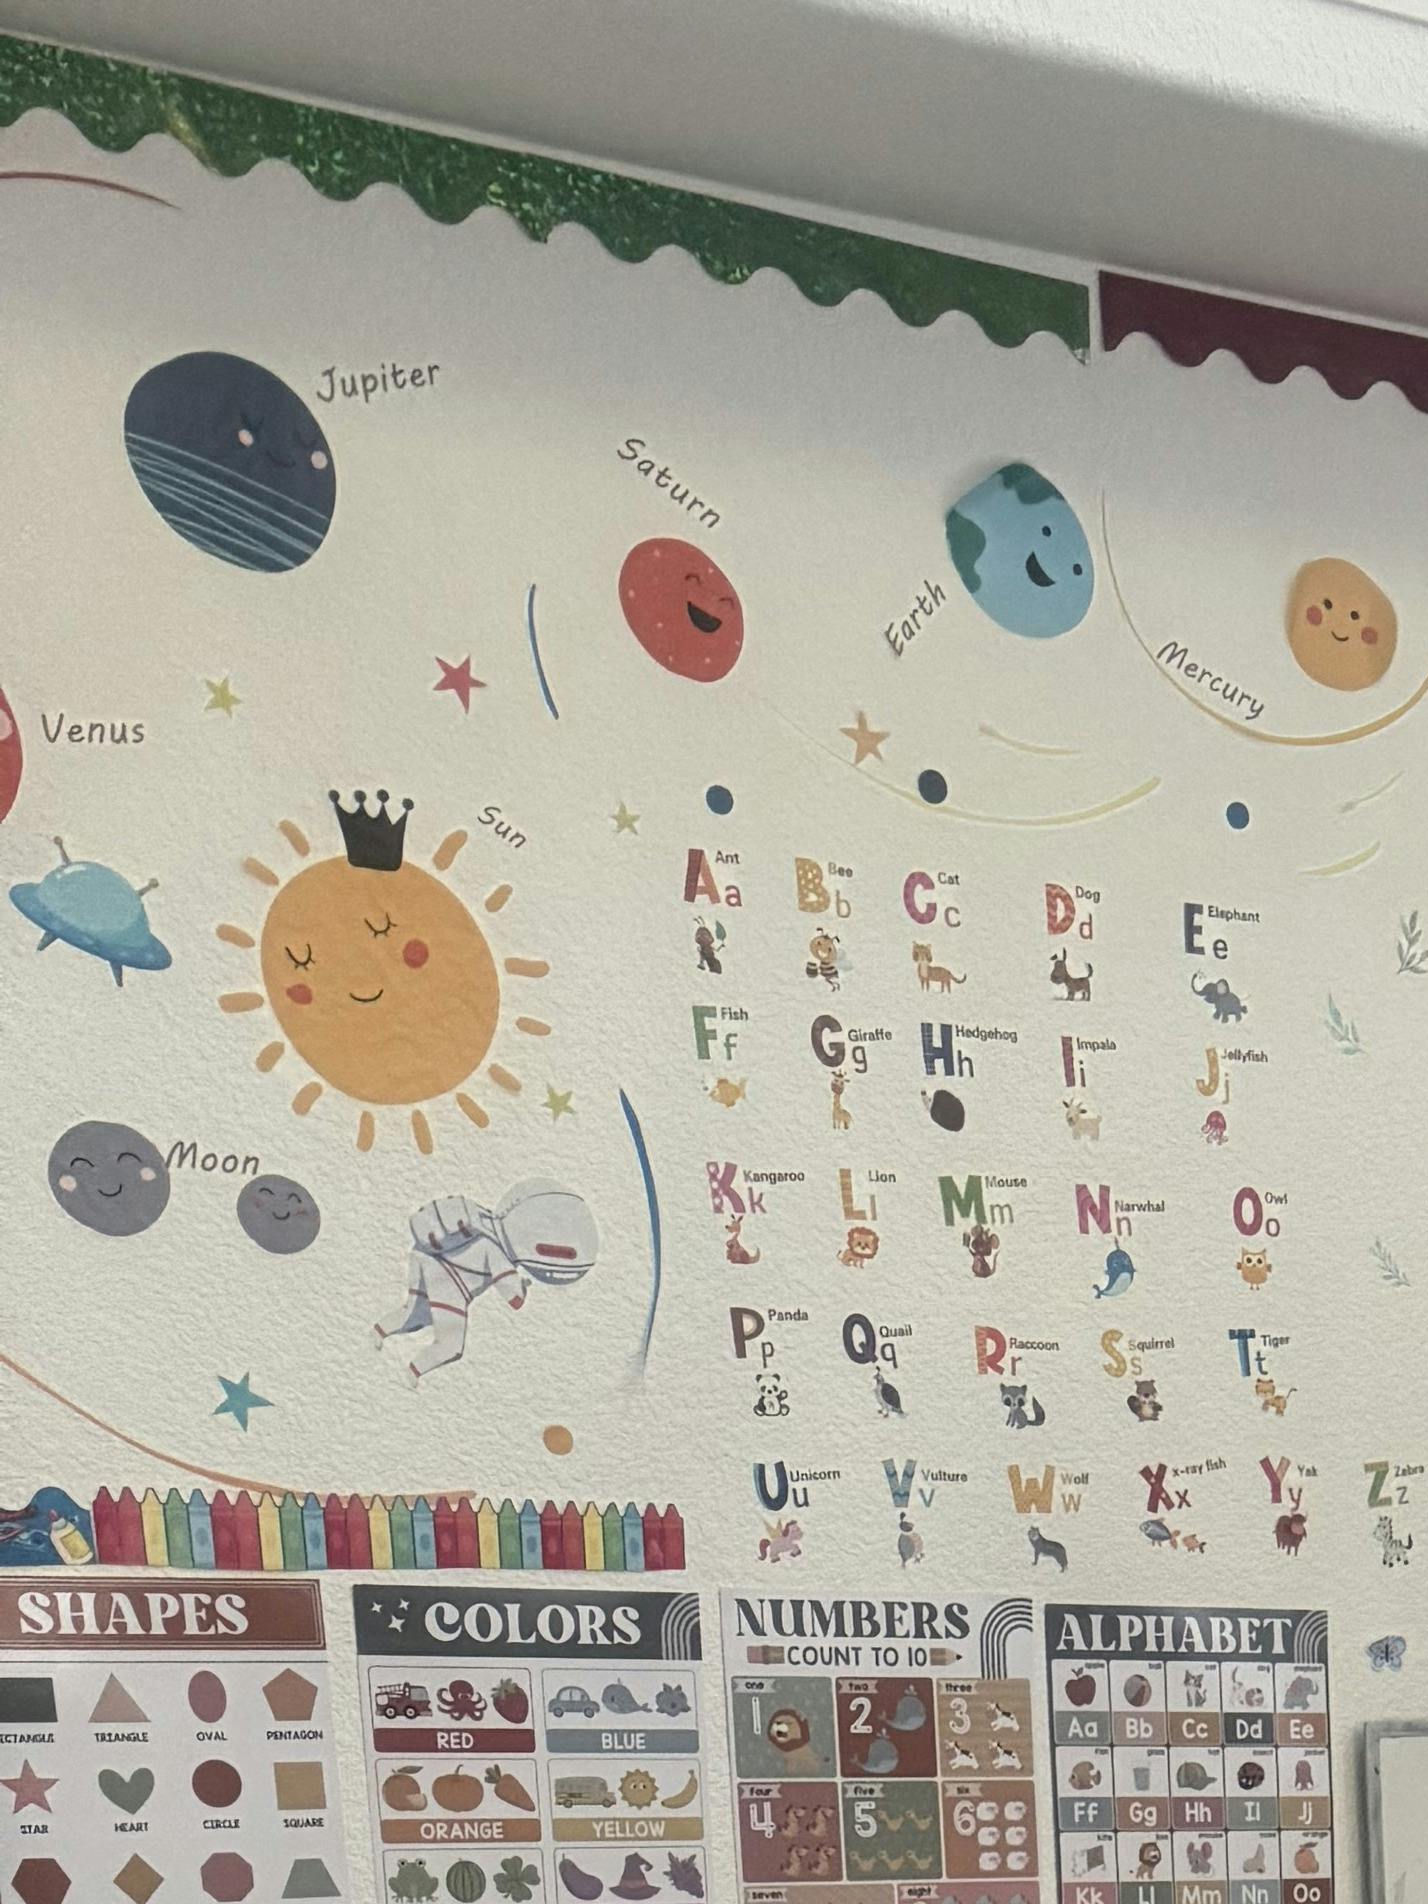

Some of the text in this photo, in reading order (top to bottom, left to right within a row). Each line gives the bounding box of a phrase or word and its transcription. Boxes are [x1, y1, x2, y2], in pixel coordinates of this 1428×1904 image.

[316, 359, 441, 405] Jupiter
[617, 436, 722, 530] Saturn
[886, 580, 947, 658] Earth
[1158, 640, 1266, 720] Mercury
[41, 712, 146, 745] Venus
[478, 803, 528, 850] Sun
[715, 850, 740, 865] Ant
[938, 872, 961, 886] Cat
[1075, 886, 1101, 902] Dog
[1207, 905, 1261, 924] Elephant
[721, 1007, 749, 1021] Fish
[848, 1028, 892, 1042] Giraffe
[955, 1024, 1018, 1042] Hedgehog
[166, 1141, 259, 1175] Moon
[743, 1169, 805, 1185] Kangaroo
[868, 1170, 896, 1184] Lion
[985, 1175, 1028, 1188] Mouse
[1114, 1199, 1165, 1214] Narwhal
[768, 1309, 809, 1322] Panda
[789, 1468, 841, 1481] Unicorn
[19, 1593, 249, 1638] SHAPES
[424, 1602, 641, 1645] COLORS
[735, 1598, 970, 1640] NUMBERS
[1055, 1612, 1292, 1654] ALPHABET
[787, 1646, 927, 1668] COUNT TO 10
[848, 1700, 873, 1733] 2
[1068, 1718, 1097, 1739] Aa
[436, 1732, 474, 1749] RED
[601, 1732, 646, 1749] BLUE
[1184, 1802, 1211, 1822] Hh
[114, 1821, 148, 1833] HEART
[420, 1821, 503, 1839] ORANGE
[592, 1820, 665, 1838] YELLOW
